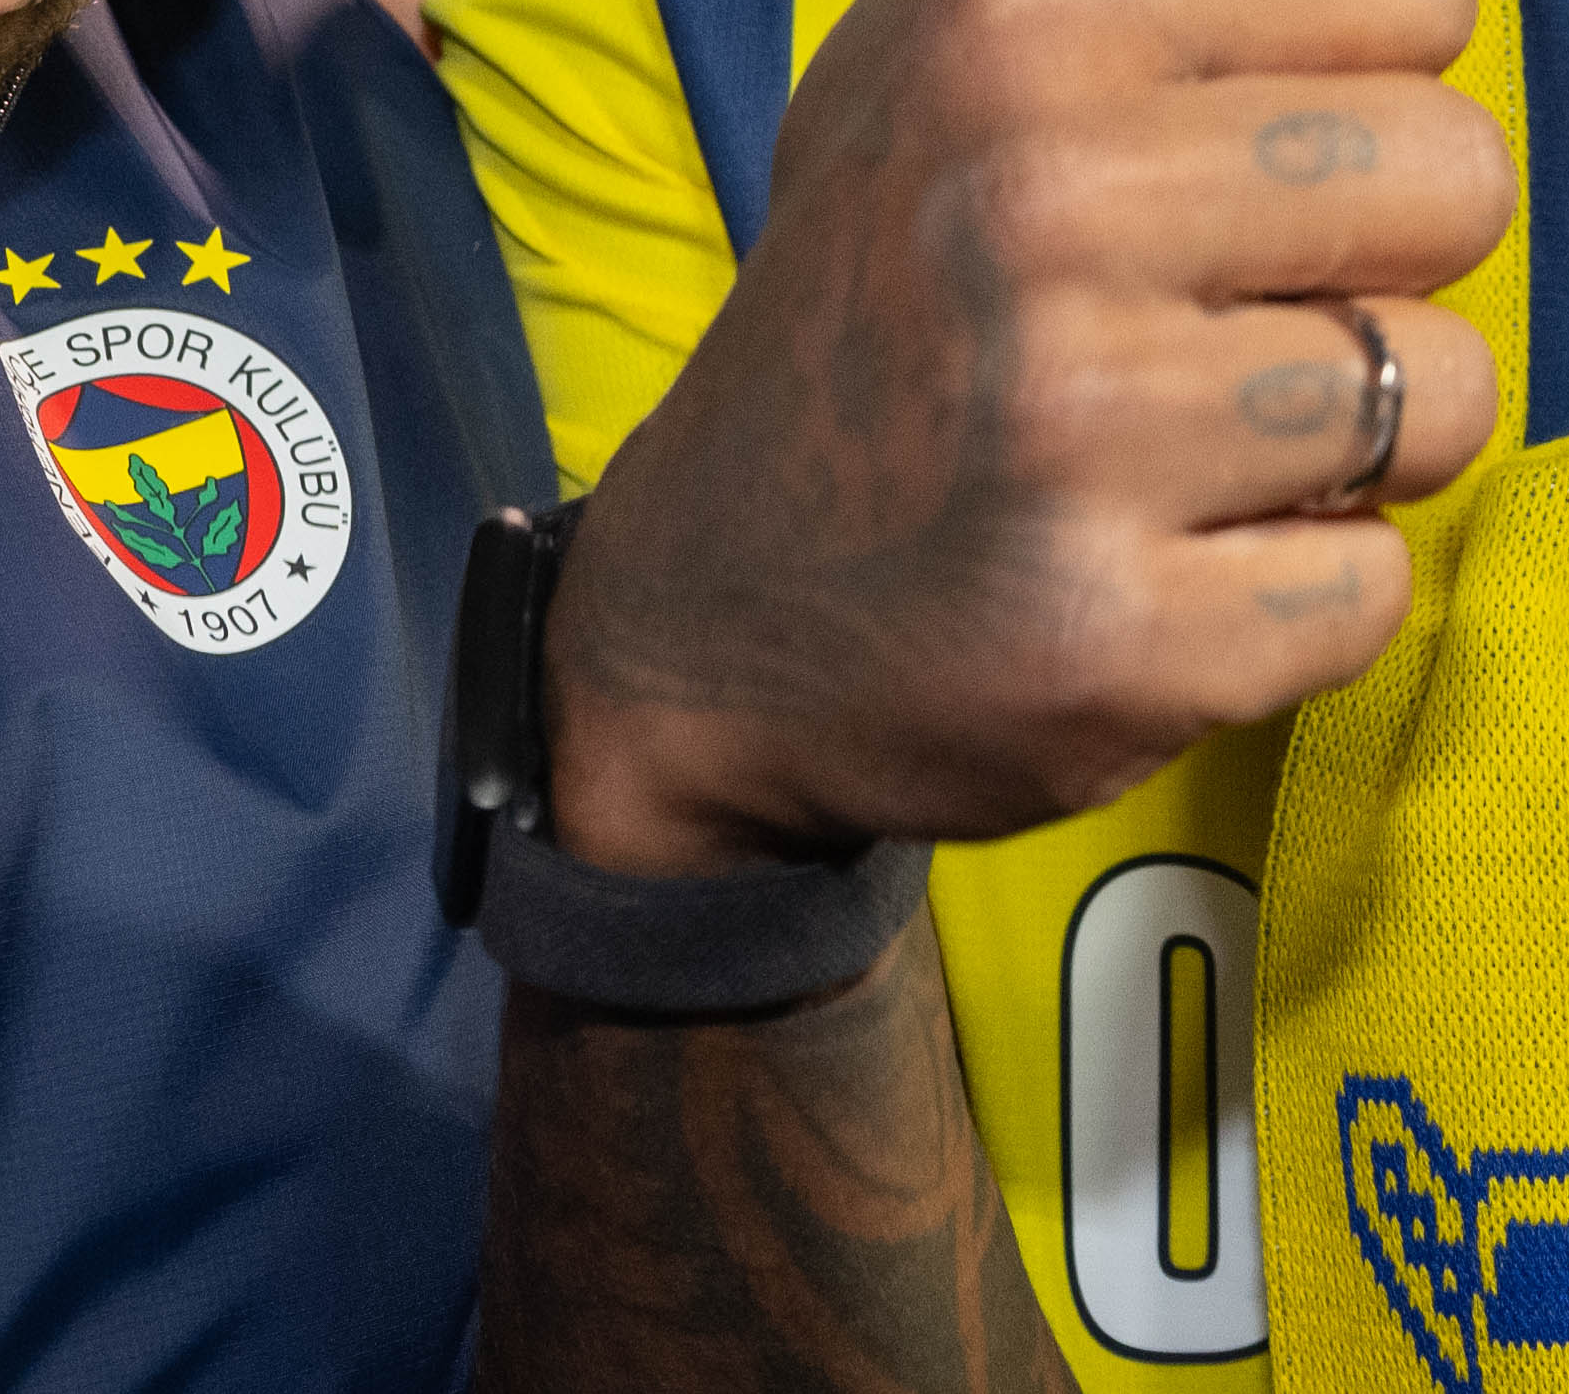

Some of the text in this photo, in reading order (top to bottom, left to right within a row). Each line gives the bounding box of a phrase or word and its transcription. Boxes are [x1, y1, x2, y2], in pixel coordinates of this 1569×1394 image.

[66, 322, 214, 371] SPOR
[229, 355, 350, 532] KULÜBÜ
[179, 589, 279, 642] 1907
